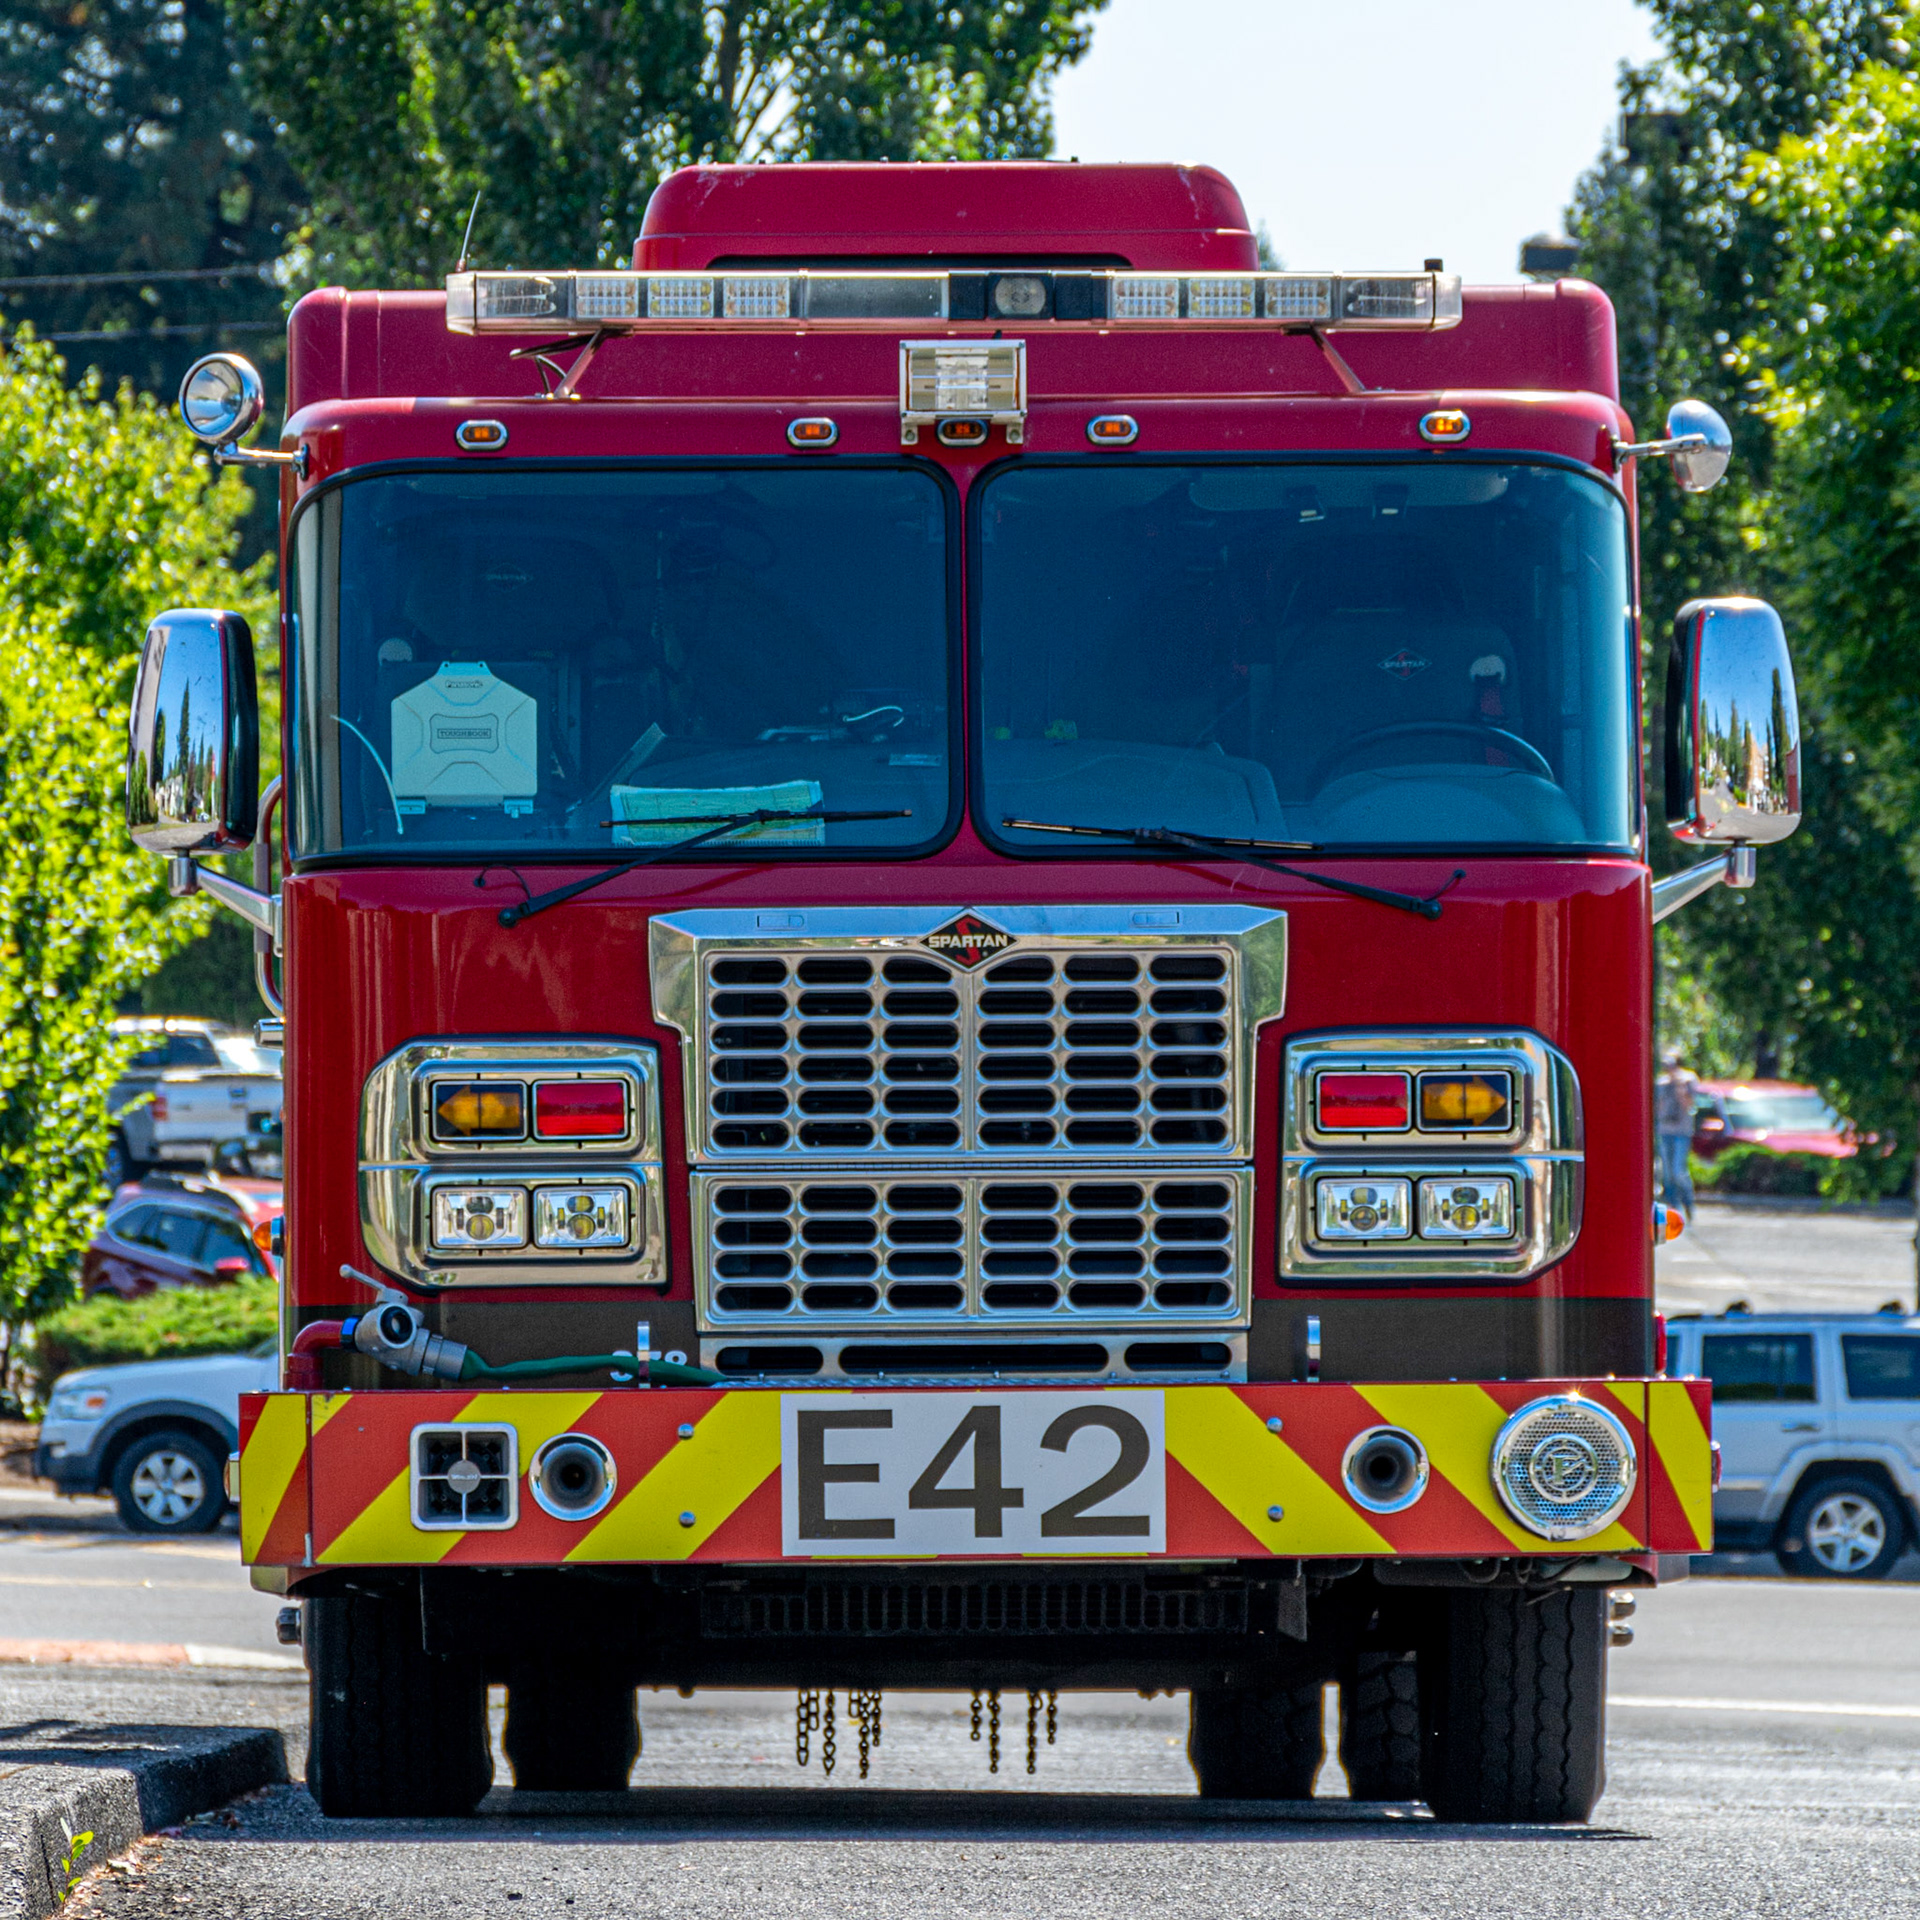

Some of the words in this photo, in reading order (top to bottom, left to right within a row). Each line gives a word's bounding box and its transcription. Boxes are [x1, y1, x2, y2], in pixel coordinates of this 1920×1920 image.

[439, 730, 490, 738] TOUGHBOOK
[928, 934, 1008, 948] SPARTAN
[797, 1404, 1150, 1539] E42
